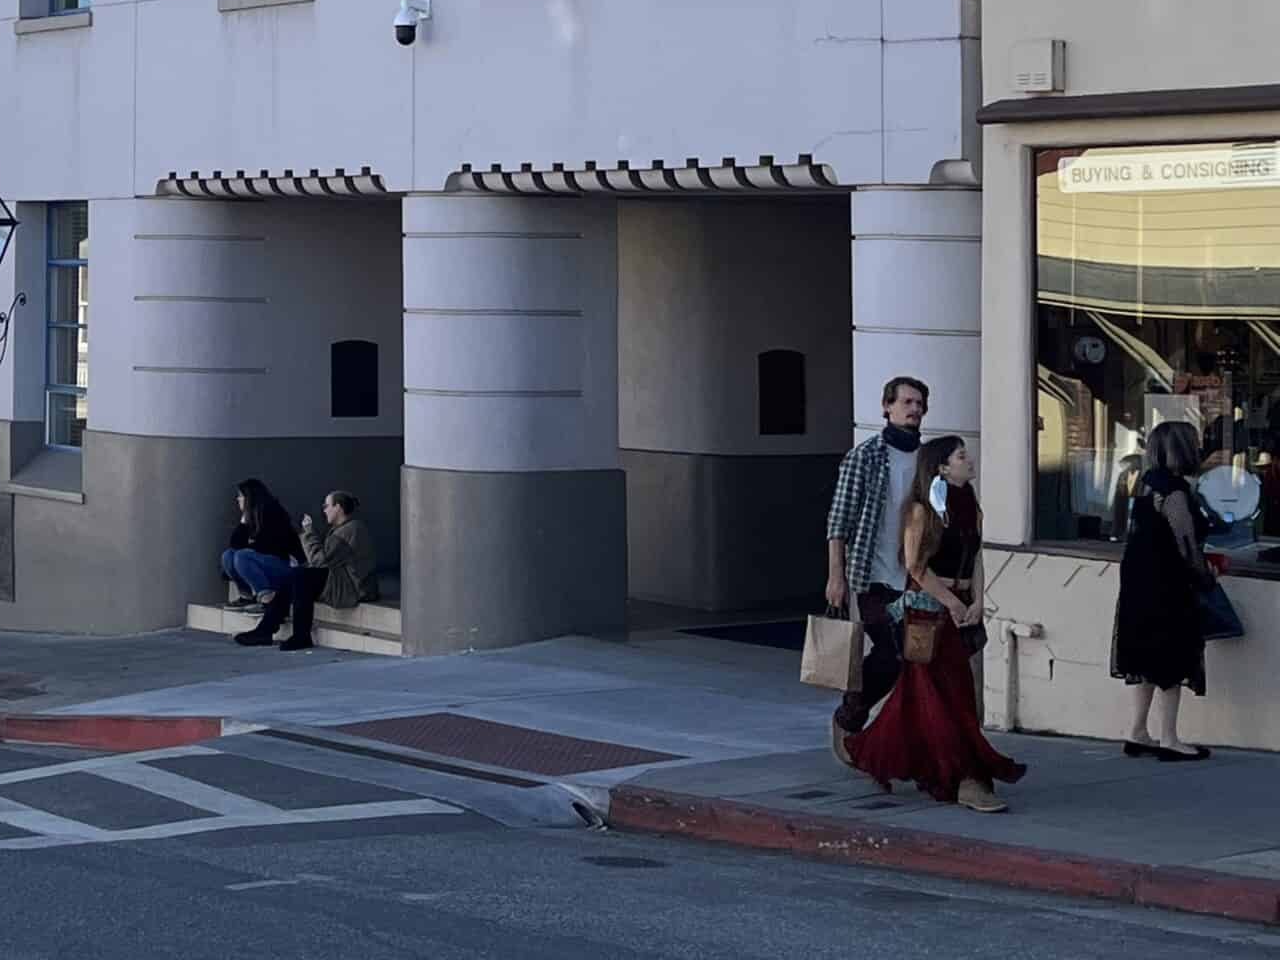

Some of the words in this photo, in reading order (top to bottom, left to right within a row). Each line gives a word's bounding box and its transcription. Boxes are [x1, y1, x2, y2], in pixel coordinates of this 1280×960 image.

[1072, 166, 1132, 184] BUYING
[1143, 164, 1153, 181] &
[1161, 159, 1272, 181] CONSIGNING
